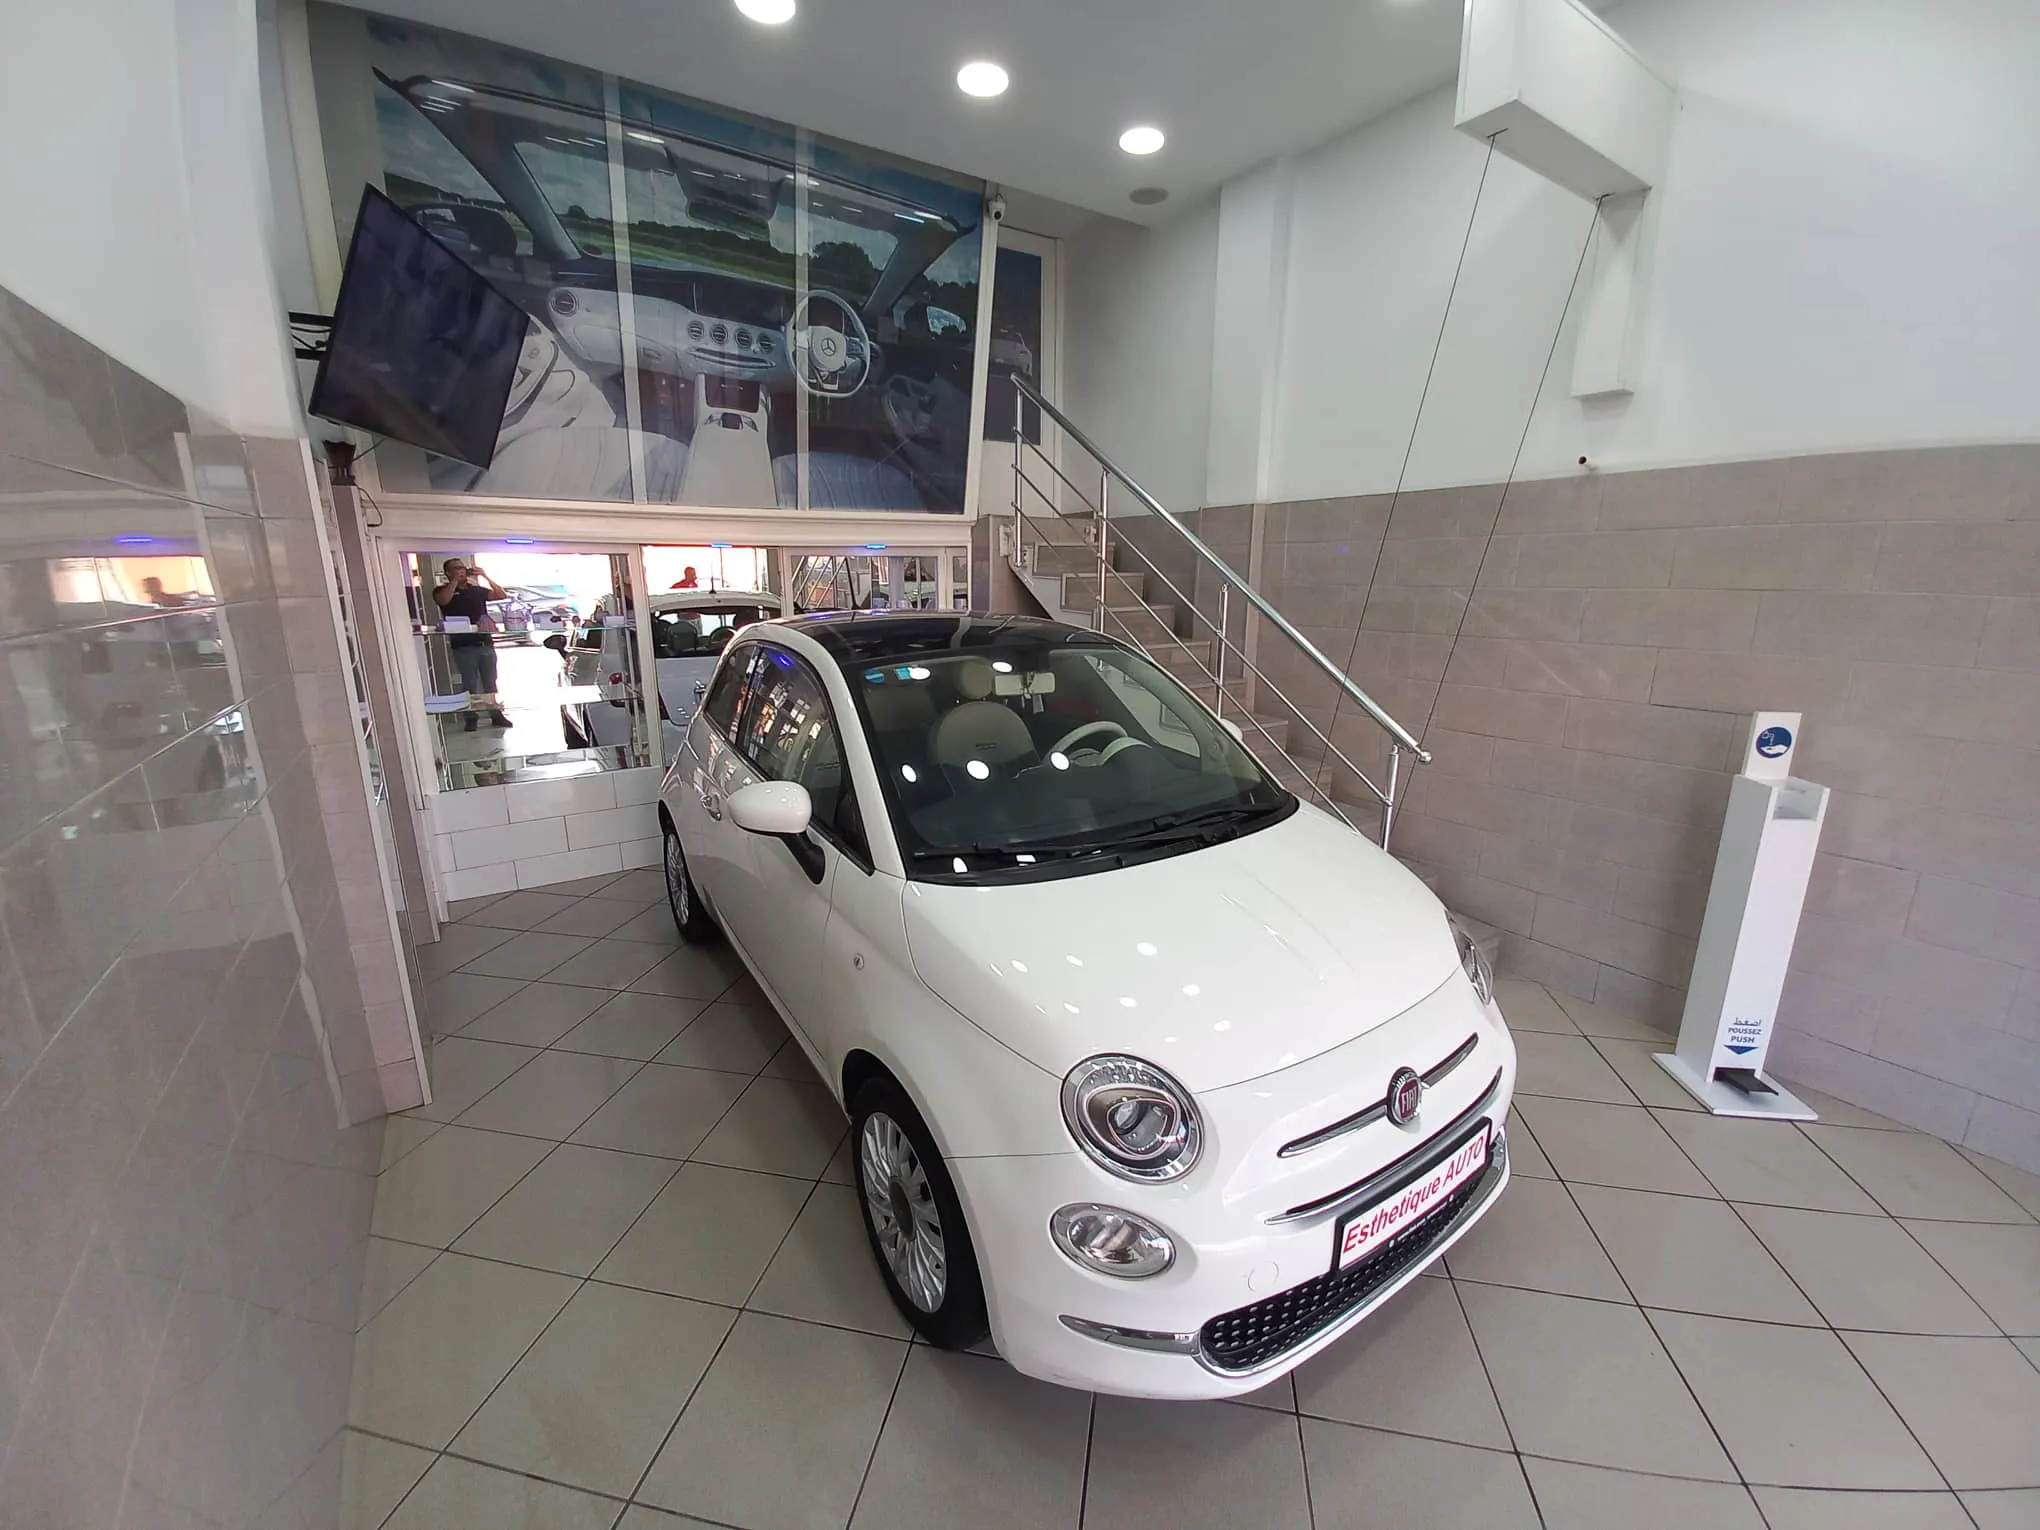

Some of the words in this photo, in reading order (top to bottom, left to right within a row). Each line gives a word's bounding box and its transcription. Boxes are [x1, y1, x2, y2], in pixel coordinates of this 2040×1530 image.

[1728, 1027, 1761, 1035] POUSSEZ
[1731, 1035, 1755, 1043] PUSH
[1401, 1086, 1417, 1114] FIAT
[1343, 1175, 1441, 1254] Esthetique
[1442, 1135, 1484, 1187] AUTO
